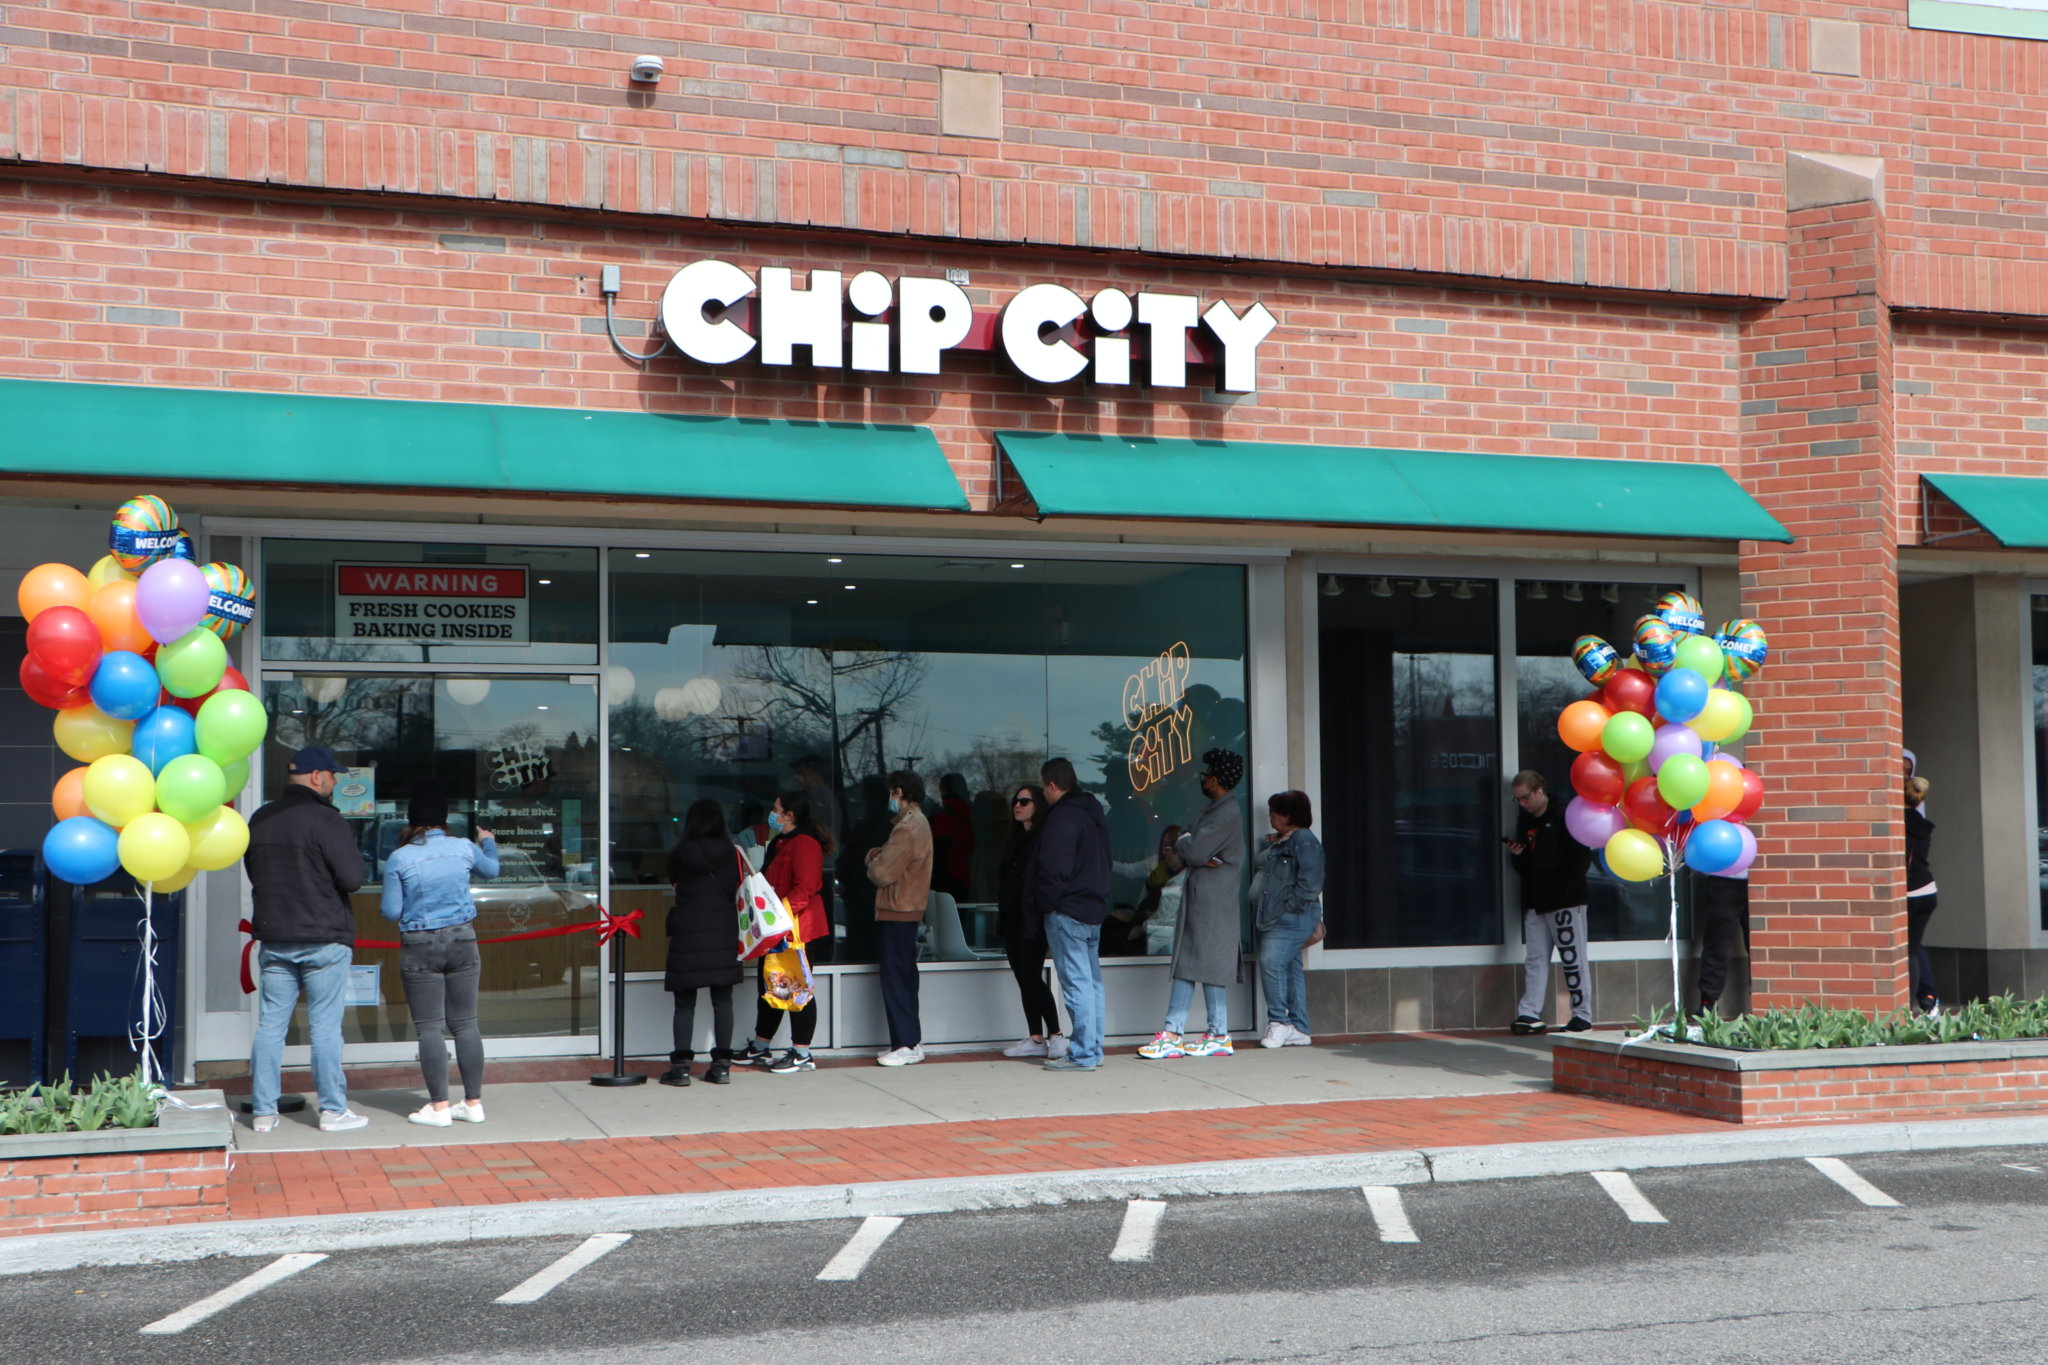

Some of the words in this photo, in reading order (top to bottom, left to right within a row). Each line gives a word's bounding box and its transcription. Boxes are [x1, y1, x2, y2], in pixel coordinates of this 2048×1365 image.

[365, 572, 498, 593] WARNING
[208, 594, 255, 619] ELCOME
[349, 602, 418, 618] FRESH
[423, 603, 516, 619] COOKIES
[353, 622, 436, 638] BAKING
[441, 623, 513, 639] INSIDE
